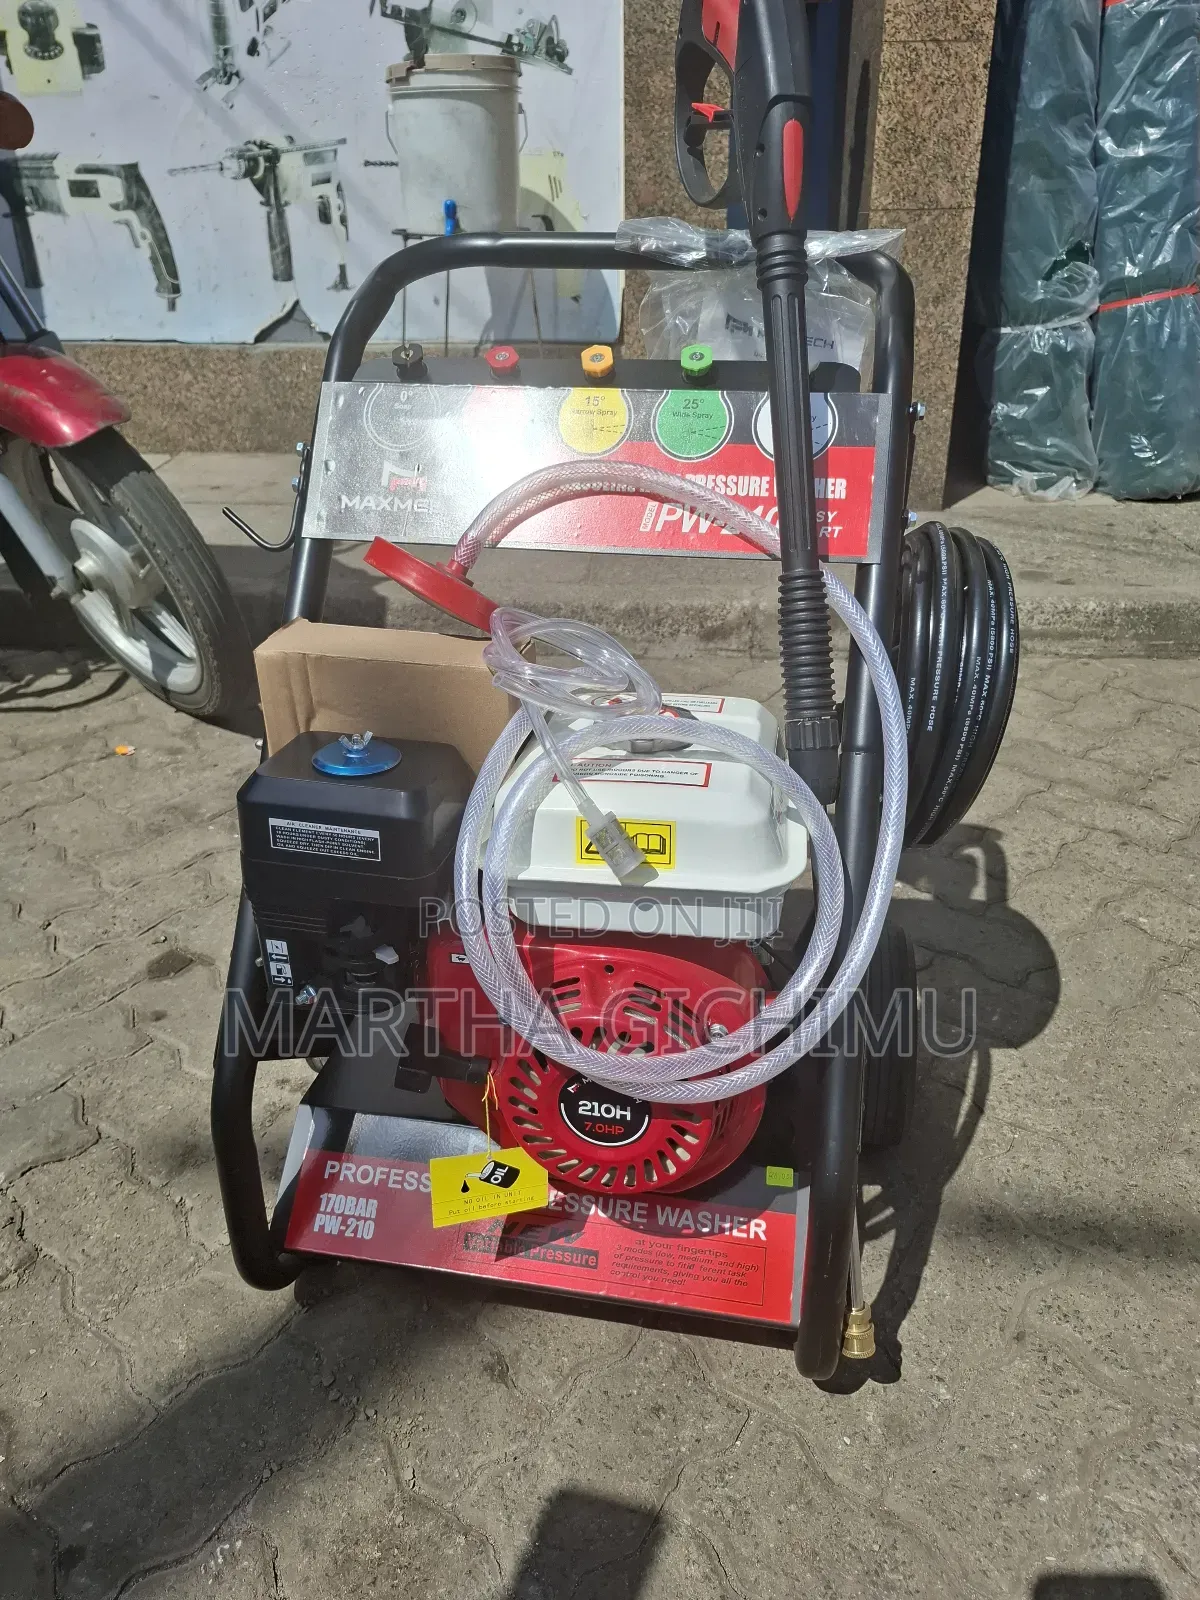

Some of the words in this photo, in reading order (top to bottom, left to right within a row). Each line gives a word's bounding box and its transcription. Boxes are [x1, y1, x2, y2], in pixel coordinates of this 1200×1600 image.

[585, 395, 606, 406] 15°
[682, 398, 705, 410] 25°
[597, 409, 618, 417] Spray
[692, 411, 714, 420] Spray
[642, 503, 657, 530] MODEL
[816, 511, 837, 523] SY
[932, 650, 943, 701] PRESSURE
[908, 677, 916, 703] MAX.
[927, 705, 937, 732] HOSE
[578, 1100, 631, 1121] 210H
[584, 1121, 625, 1135] 7.0HP
[490, 1166, 509, 1184] OIL
[324, 1160, 431, 1193] PROFESS
[547, 1192, 649, 1223] ESSURE
[656, 1204, 767, 1241] WASHER
[464, 1205, 475, 1213] oil
[478, 1202, 502, 1210] before
[505, 1196, 535, 1206] starting
[504, 1190, 521, 1198] UNIT
[320, 1192, 379, 1219] 170BAR
[313, 1213, 376, 1240] PW-210
[529, 1246, 598, 1267] Pressure
[624, 1246, 653, 1256] modes
[655, 1250, 675, 1260] (low,
[717, 1259, 735, 1268] and
[737, 1262, 760, 1273] high)
[648, 1241, 673, 1251] your
[677, 1243, 728, 1259] fingertips
[611, 1261, 670, 1276] requirements,
[673, 1270, 700, 1281] giving
[702, 1274, 718, 1283] you
[721, 1277, 732, 1285] all
[625, 1255, 663, 1266] pressure
[728, 1270, 747, 1278] task
[610, 1269, 641, 1279] control
[642, 1273, 659, 1283] you
[661, 1277, 686, 1286] need!
